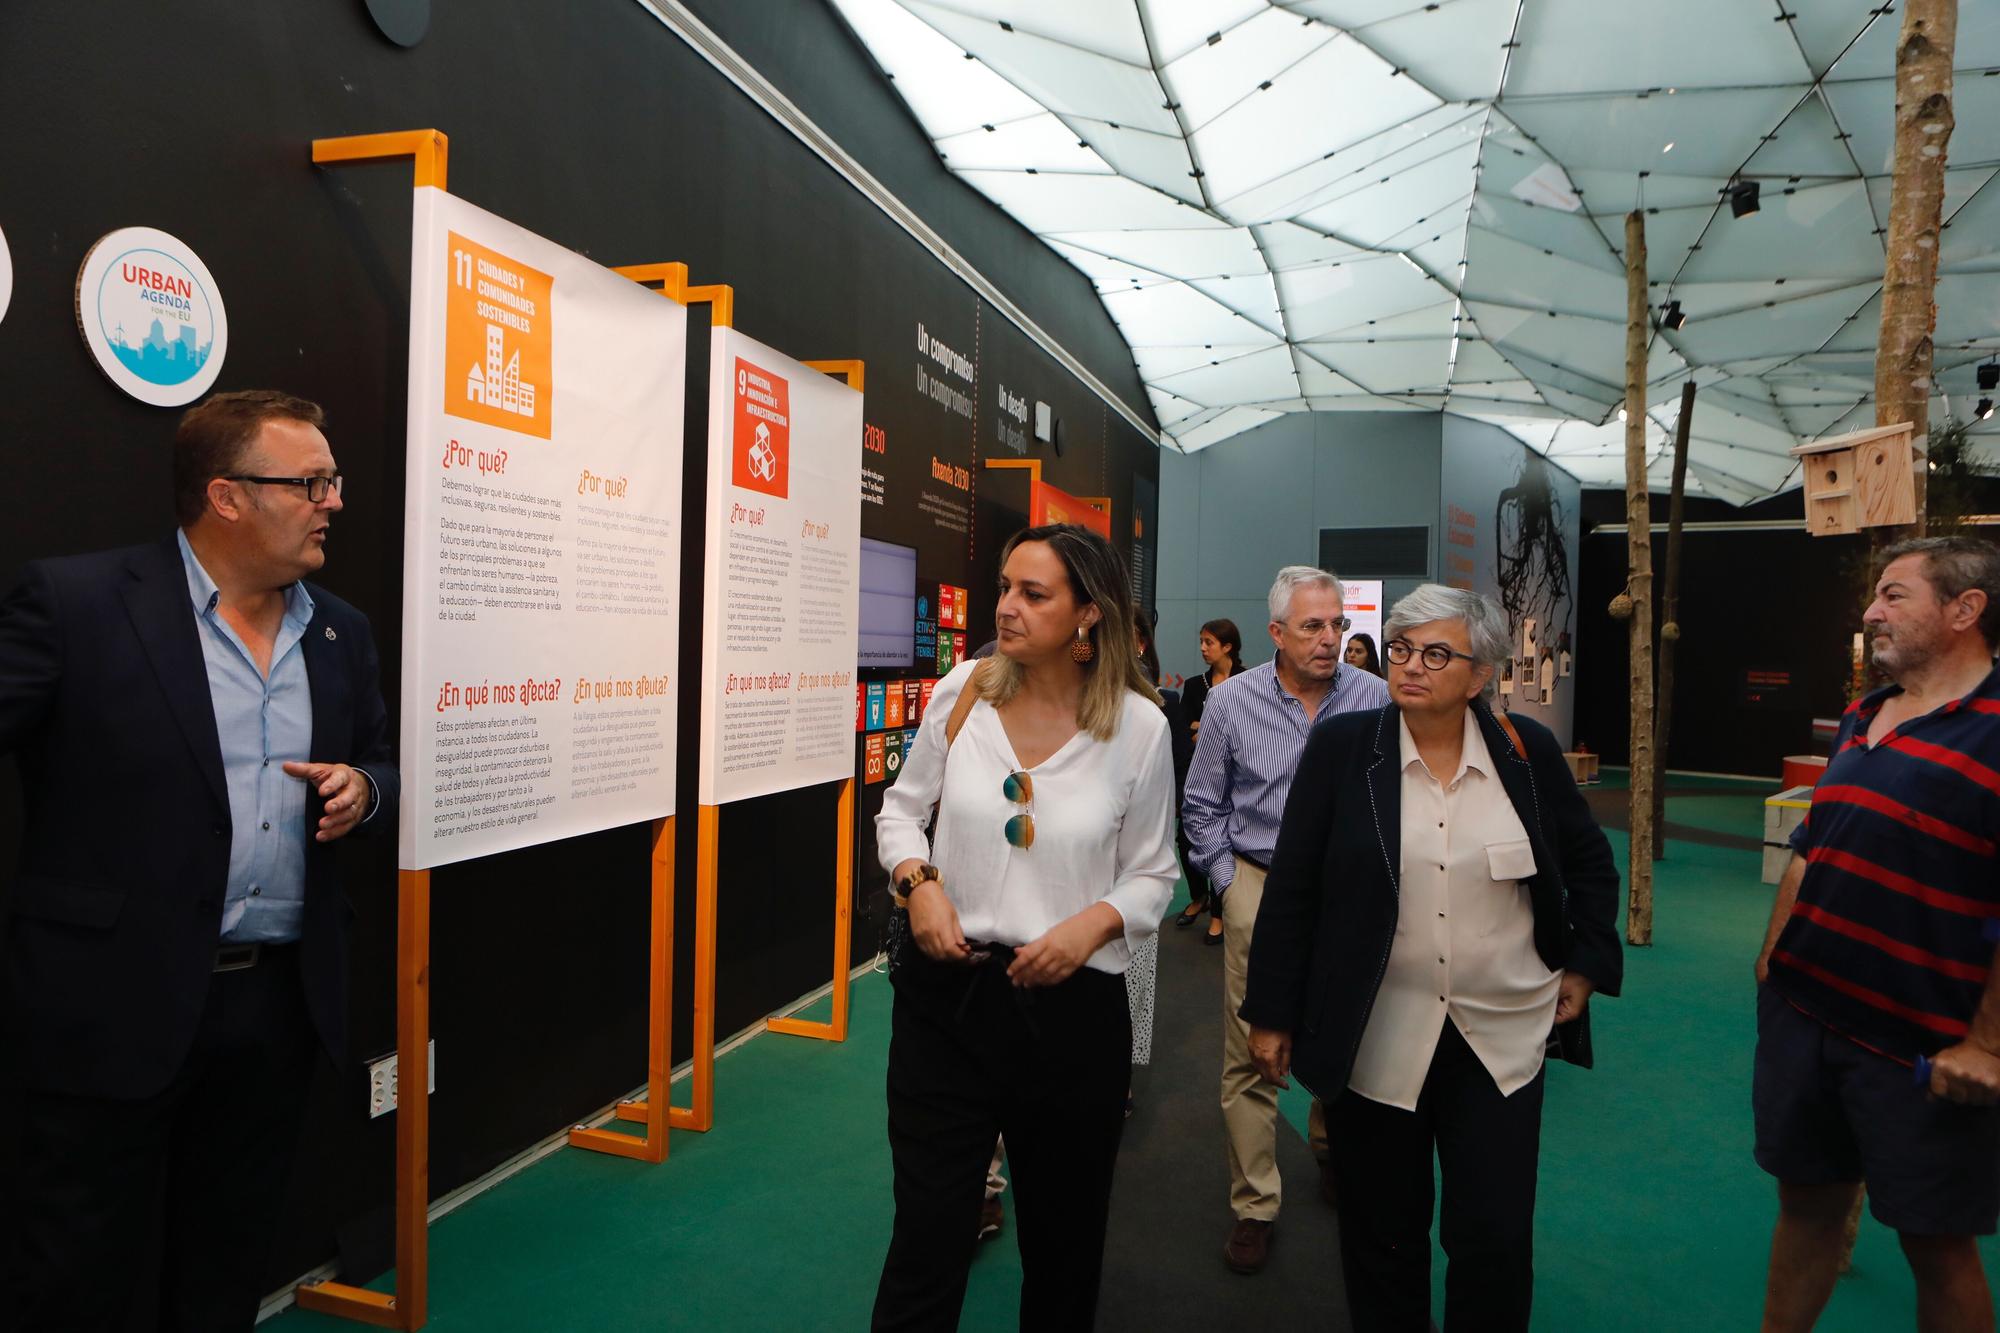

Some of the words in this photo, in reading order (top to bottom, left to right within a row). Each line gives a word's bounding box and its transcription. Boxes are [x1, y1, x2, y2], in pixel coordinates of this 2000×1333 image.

[123, 263, 191, 298] URBAN
[454, 250, 471, 290] 11
[478, 259, 517, 288] CIUDADES
[519, 277, 524, 291] Y
[141, 289, 191, 311] AGENDA
[478, 280, 535, 315] COMUNIDADES
[166, 310, 176, 318] THE
[179, 310, 190, 321] EU
[477, 301, 530, 333] SOSTENIBLES
[918, 323, 928, 355] Un
[930, 338, 973, 383] compromiso
[739, 369, 746, 395] 9
[916, 364, 927, 395] Un
[999, 384, 1006, 411] Un
[865, 424, 885, 454] 2030
[998, 418, 1006, 444] Un
[443, 440, 473, 468] ¿Por
[479, 448, 507, 476] qué?
[578, 470, 601, 494] ¿Por
[605, 476, 627, 500] qué?
[932, 456, 953, 485] Axenda
[955, 466, 969, 491] 2030
[442, 478, 471, 492] Debemos
[473, 484, 489, 496] lograr
[491, 488, 501, 497] que
[512, 491, 536, 503] ciudades
[537, 496, 549, 505] sean
[499, 506, 526, 515] resilientes
[731, 503, 747, 523] ¿Por
[749, 508, 764, 527] qué?
[441, 518, 457, 529] Dado
[459, 523, 470, 532] que
[472, 525, 484, 533] para
[486, 524, 491, 534] la
[524, 531, 548, 541] personas
[549, 534, 554, 542] el
[802, 520, 815, 538] ¿Por
[817, 523, 829, 541] qué?
[440, 533, 460, 544] futuro
[461, 537, 474, 547] será
[508, 543, 536, 553] soluciones
[542, 547, 561, 557] algunos
[440, 548, 448, 559] de
[450, 550, 458, 560] los
[460, 552, 492, 564] principales
[493, 555, 522, 566] problemas
[528, 560, 538, 568] que
[440, 564, 470, 576] enfrentan
[481, 570, 497, 578] seres
[498, 570, 524, 580] humanos
[440, 580, 445, 588] el
[446, 580, 469, 591] cambio
[499, 584, 504, 593] la
[506, 586, 532, 595] asistencia
[533, 587, 555, 596] sanitaria
[439, 595, 444, 604] la
[484, 597, 502, 607] deben
[504, 598, 536, 609] encontrarse
[545, 601, 550, 610] la
[439, 610, 447, 619] de
[448, 610, 453, 620] la
[574, 678, 590, 704] ¿En
[595, 675, 612, 703] qué
[616, 681, 632, 696] nos
[636, 676, 668, 699] afeuta?
[726, 674, 737, 694] ¿En
[740, 672, 752, 694] qué
[755, 676, 766, 689] nos
[769, 672, 790, 691] afecta?
[798, 672, 806, 691] ¿En
[809, 673, 818, 692] qué
[821, 675, 830, 687] nos
[437, 682, 459, 712] ¿En
[466, 680, 488, 711] qué
[494, 685, 515, 703] nos
[520, 678, 560, 706] afecta?
[436, 721, 453, 732] Estos
[455, 720, 486, 732] problemas
[471, 733, 488, 744] todos
[489, 733, 497, 742] los
[531, 729, 538, 738] La
[436, 748, 472, 764] desigualdad
[474, 748, 492, 759] puede
[494, 746, 518, 757] provocar
[519, 744, 545, 753] disturbios
[474, 763, 479, 773] la
[523, 756, 547, 766] deteriora
[548, 754, 552, 763] la
[435, 781, 452, 793] salud
[454, 780, 461, 790] de
[462, 778, 479, 789] todos
[485, 775, 503, 786] afecta
[509, 773, 513, 782] la
[515, 768, 550, 783] productividad
[435, 798, 443, 808] de
[444, 797, 453, 806] los
[455, 791, 492, 806] trabajadores
[498, 789, 507, 798] por
[508, 786, 522, 795] tanto
[528, 784, 533, 792] la
[482, 802, 509, 814] desastres
[510, 799, 535, 810] naturales
[536, 796, 555, 807] pueden
[434, 828, 454, 838] alterar
[456, 823, 479, 834] nuestro
[481, 819, 496, 830] estilo
[497, 817, 504, 826] de
[505, 815, 516, 825] vida
